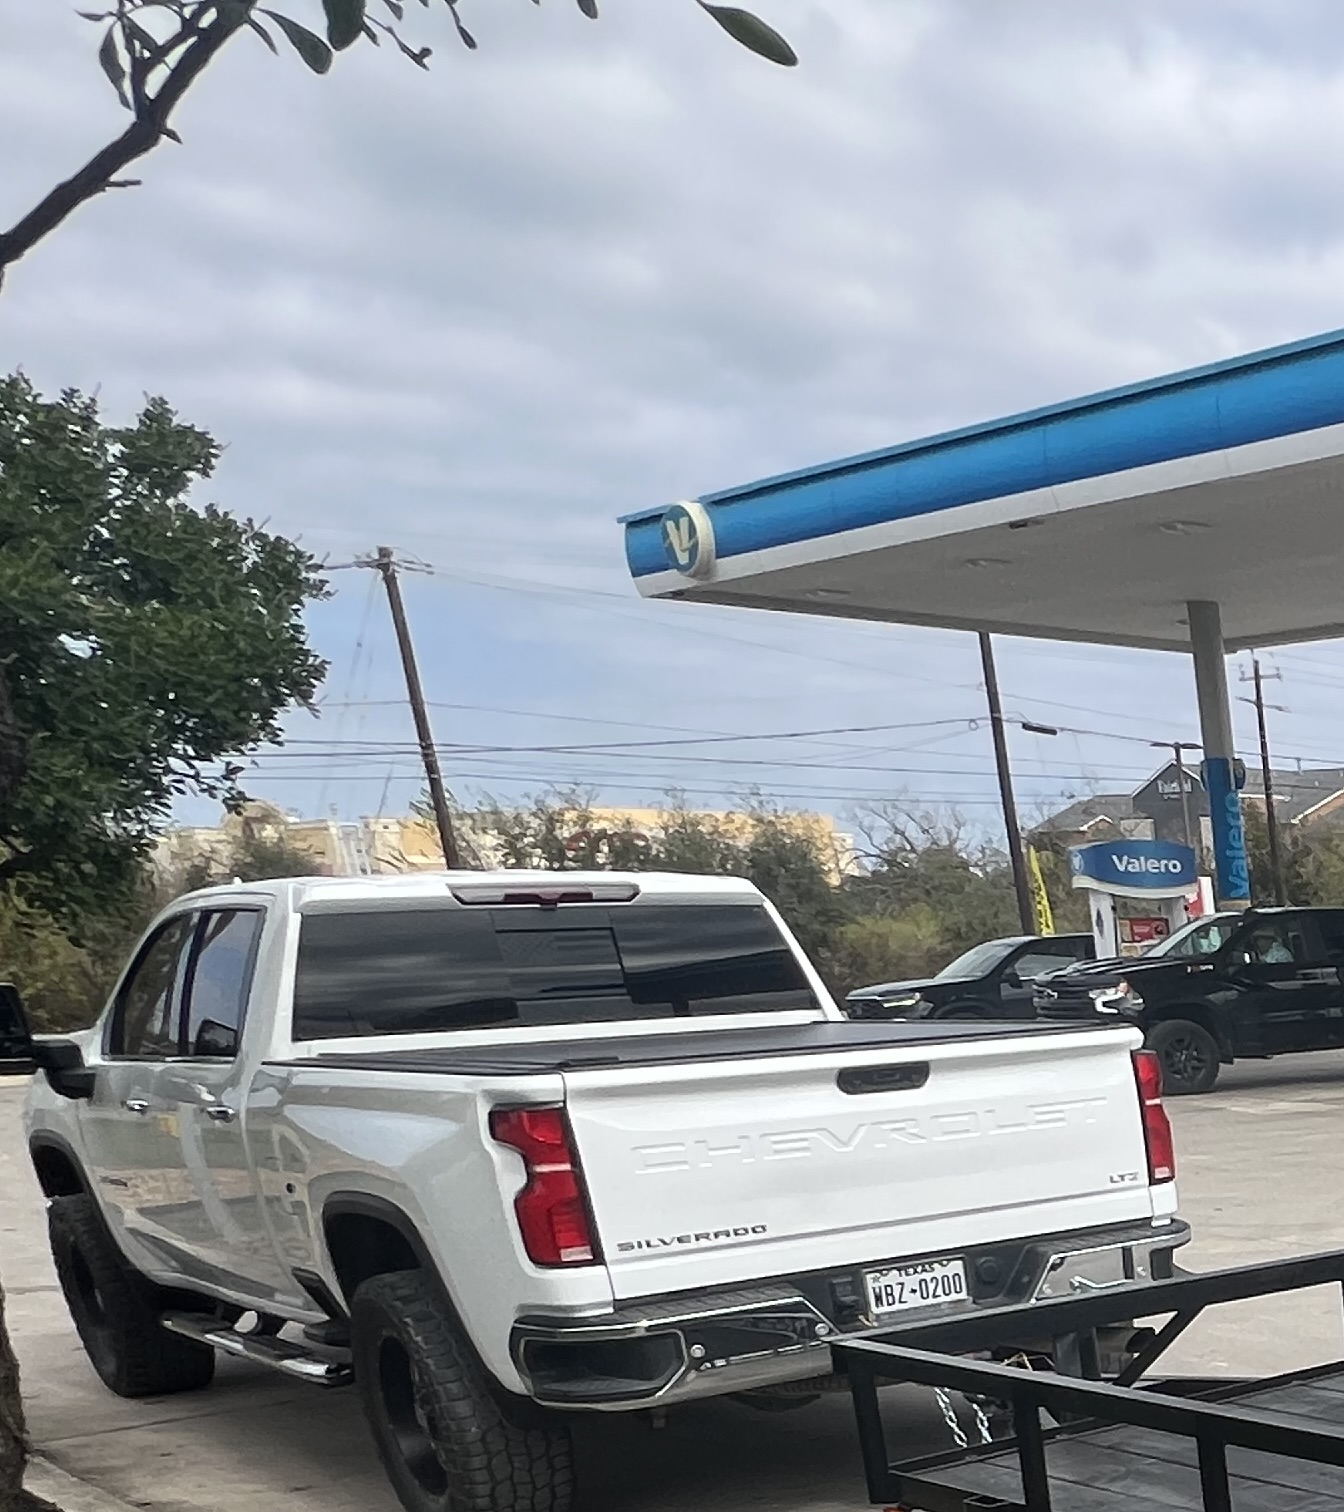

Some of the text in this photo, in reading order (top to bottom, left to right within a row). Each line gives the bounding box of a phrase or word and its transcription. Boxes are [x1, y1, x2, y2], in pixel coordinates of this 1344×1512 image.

[1223, 792, 1250, 899] Valero
[1112, 854, 1182, 874] Valero
[630, 1097, 1108, 1176] CHEVROLET
[1109, 1171, 1139, 1184] LTZ
[616, 1223, 768, 1253] SILVERADO
[898, 1263, 936, 1278] TEXAS
